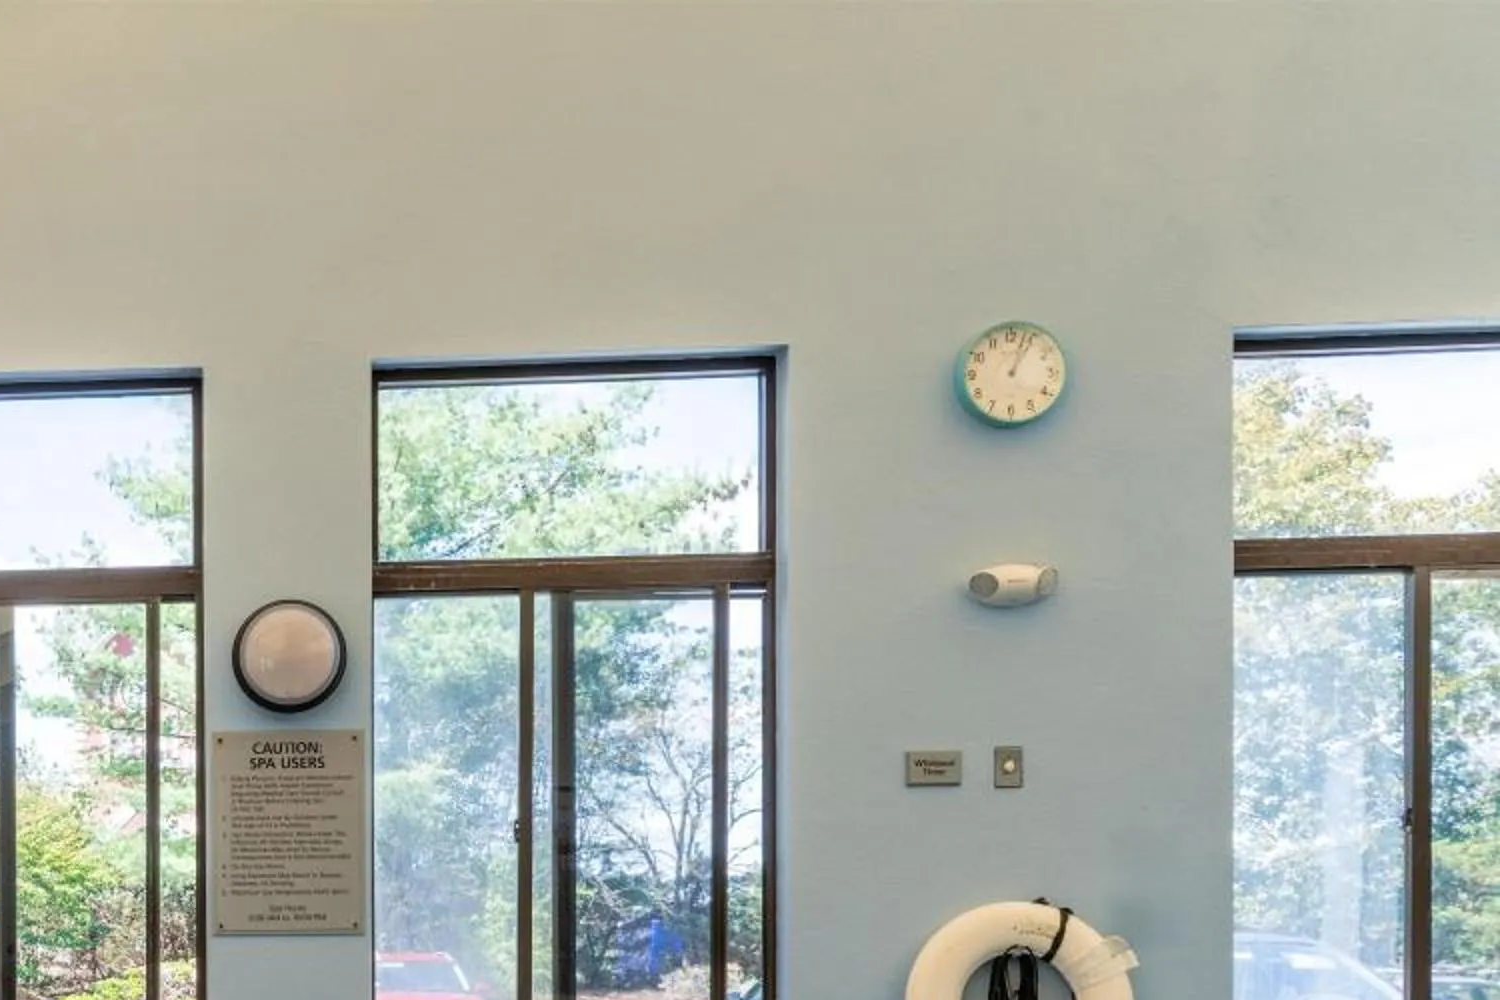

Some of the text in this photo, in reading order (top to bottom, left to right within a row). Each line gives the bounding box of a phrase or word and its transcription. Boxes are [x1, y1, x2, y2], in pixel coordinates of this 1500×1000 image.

[251, 741, 323, 755] CAUTION:
[249, 756, 325, 769] SPA USERS
